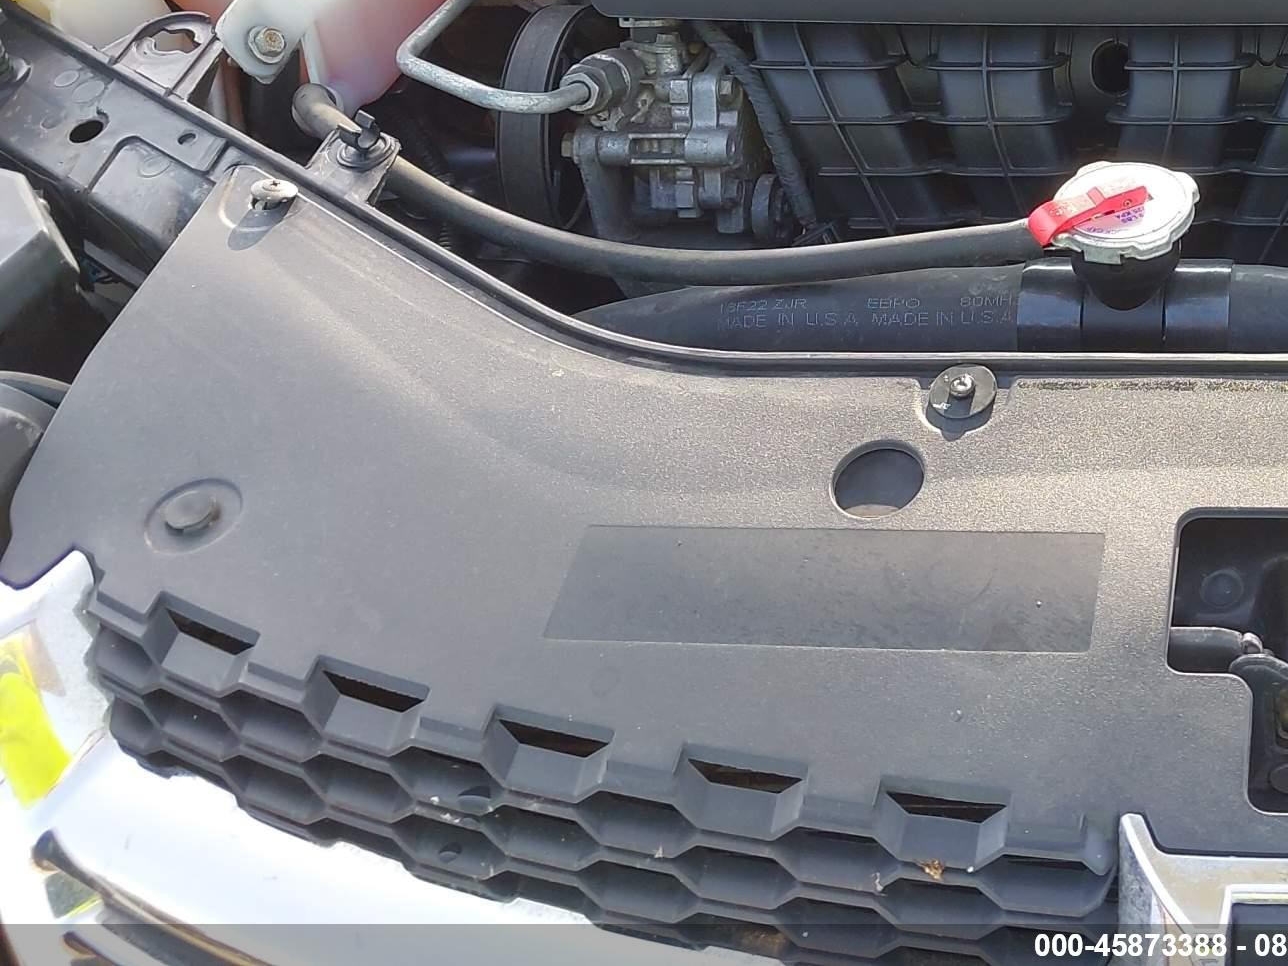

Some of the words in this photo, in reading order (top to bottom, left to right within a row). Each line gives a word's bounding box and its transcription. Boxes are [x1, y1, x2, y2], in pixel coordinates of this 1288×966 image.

[777, 313, 795, 327] IN
[871, 312, 929, 327] MADE
[935, 310, 954, 326] IN
